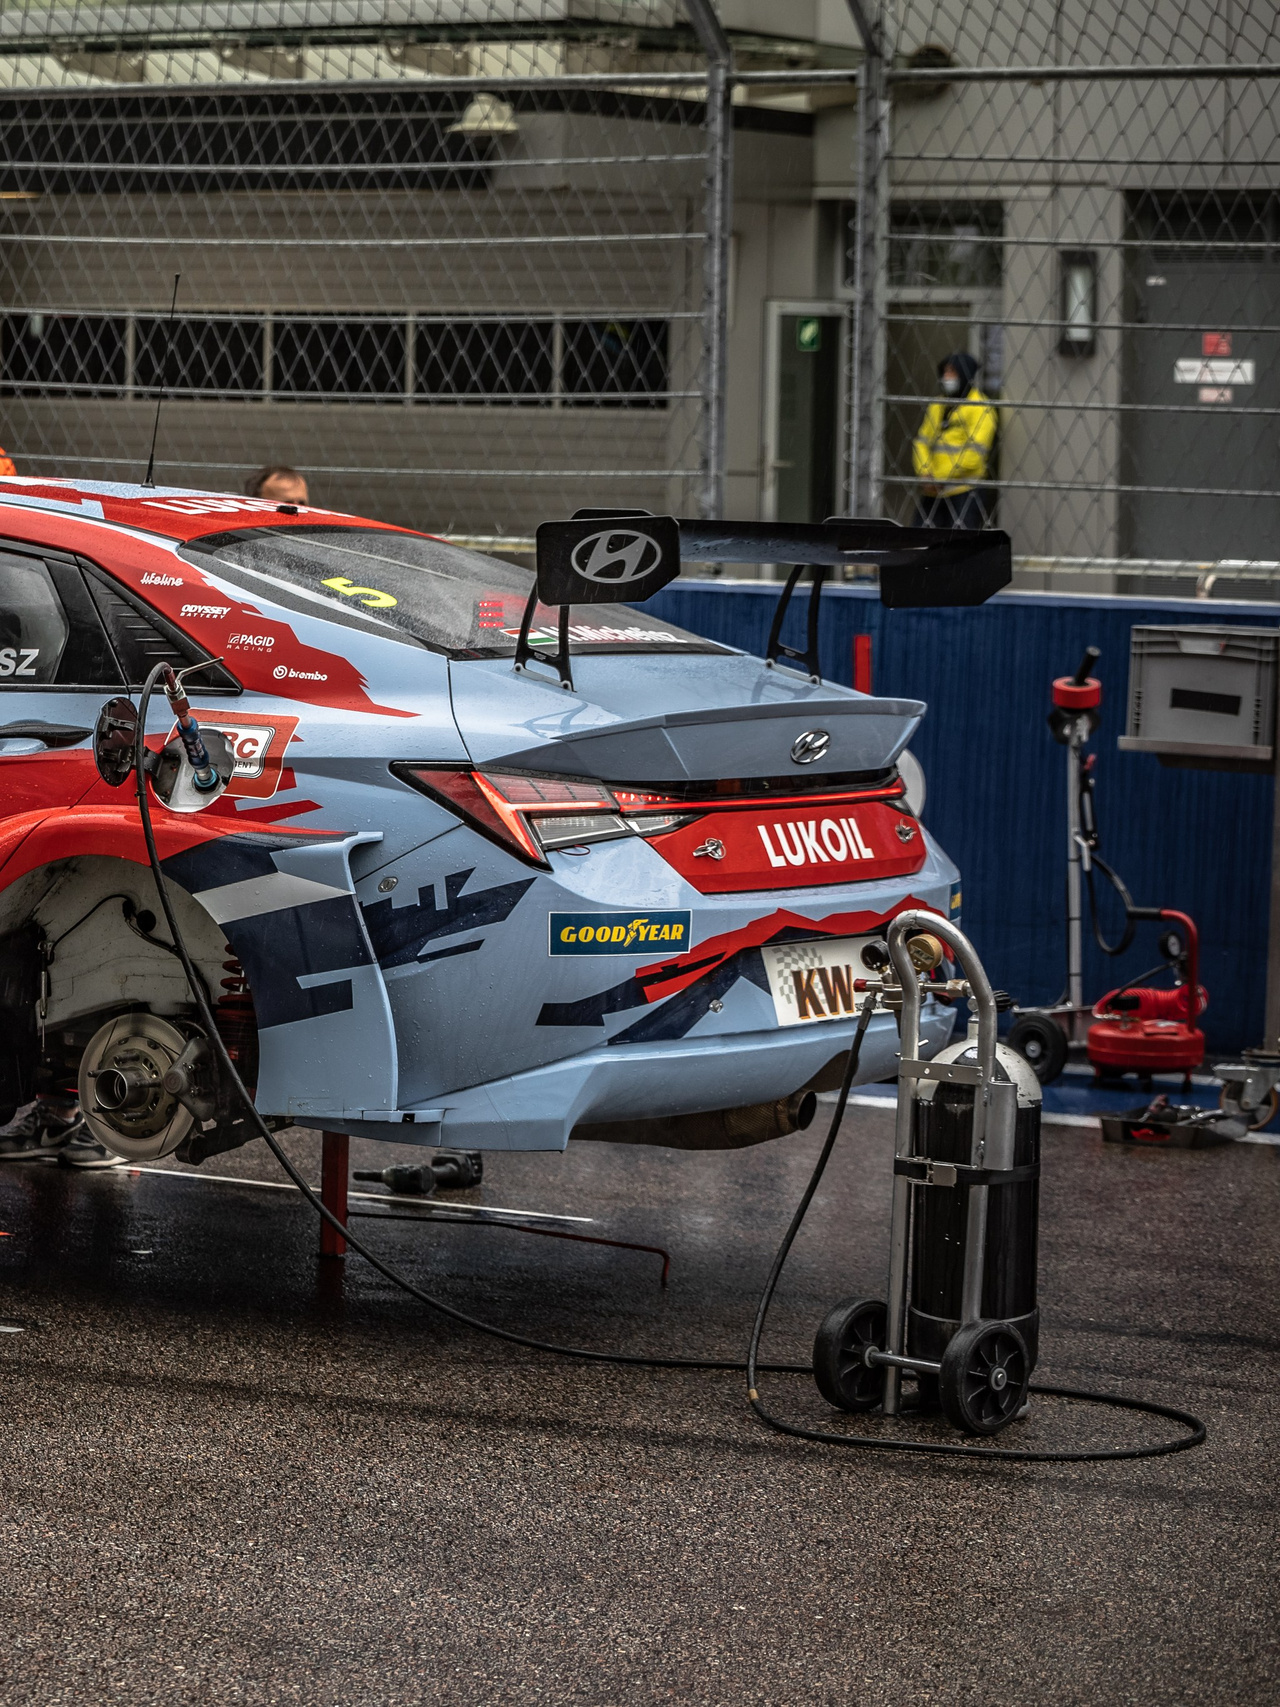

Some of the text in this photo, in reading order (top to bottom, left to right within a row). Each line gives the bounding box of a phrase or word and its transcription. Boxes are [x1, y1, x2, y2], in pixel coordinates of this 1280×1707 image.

[320, 576, 398, 608] 5
[181, 604, 232, 615] ODYSSEY
[226, 644, 273, 653] RACING
[239, 634, 275, 647] PAGID
[288, 668, 328, 681] brembo
[757, 817, 875, 868] LUKOIL
[560, 920, 685, 945] GOODYEAR
[791, 964, 856, 1020] KW
